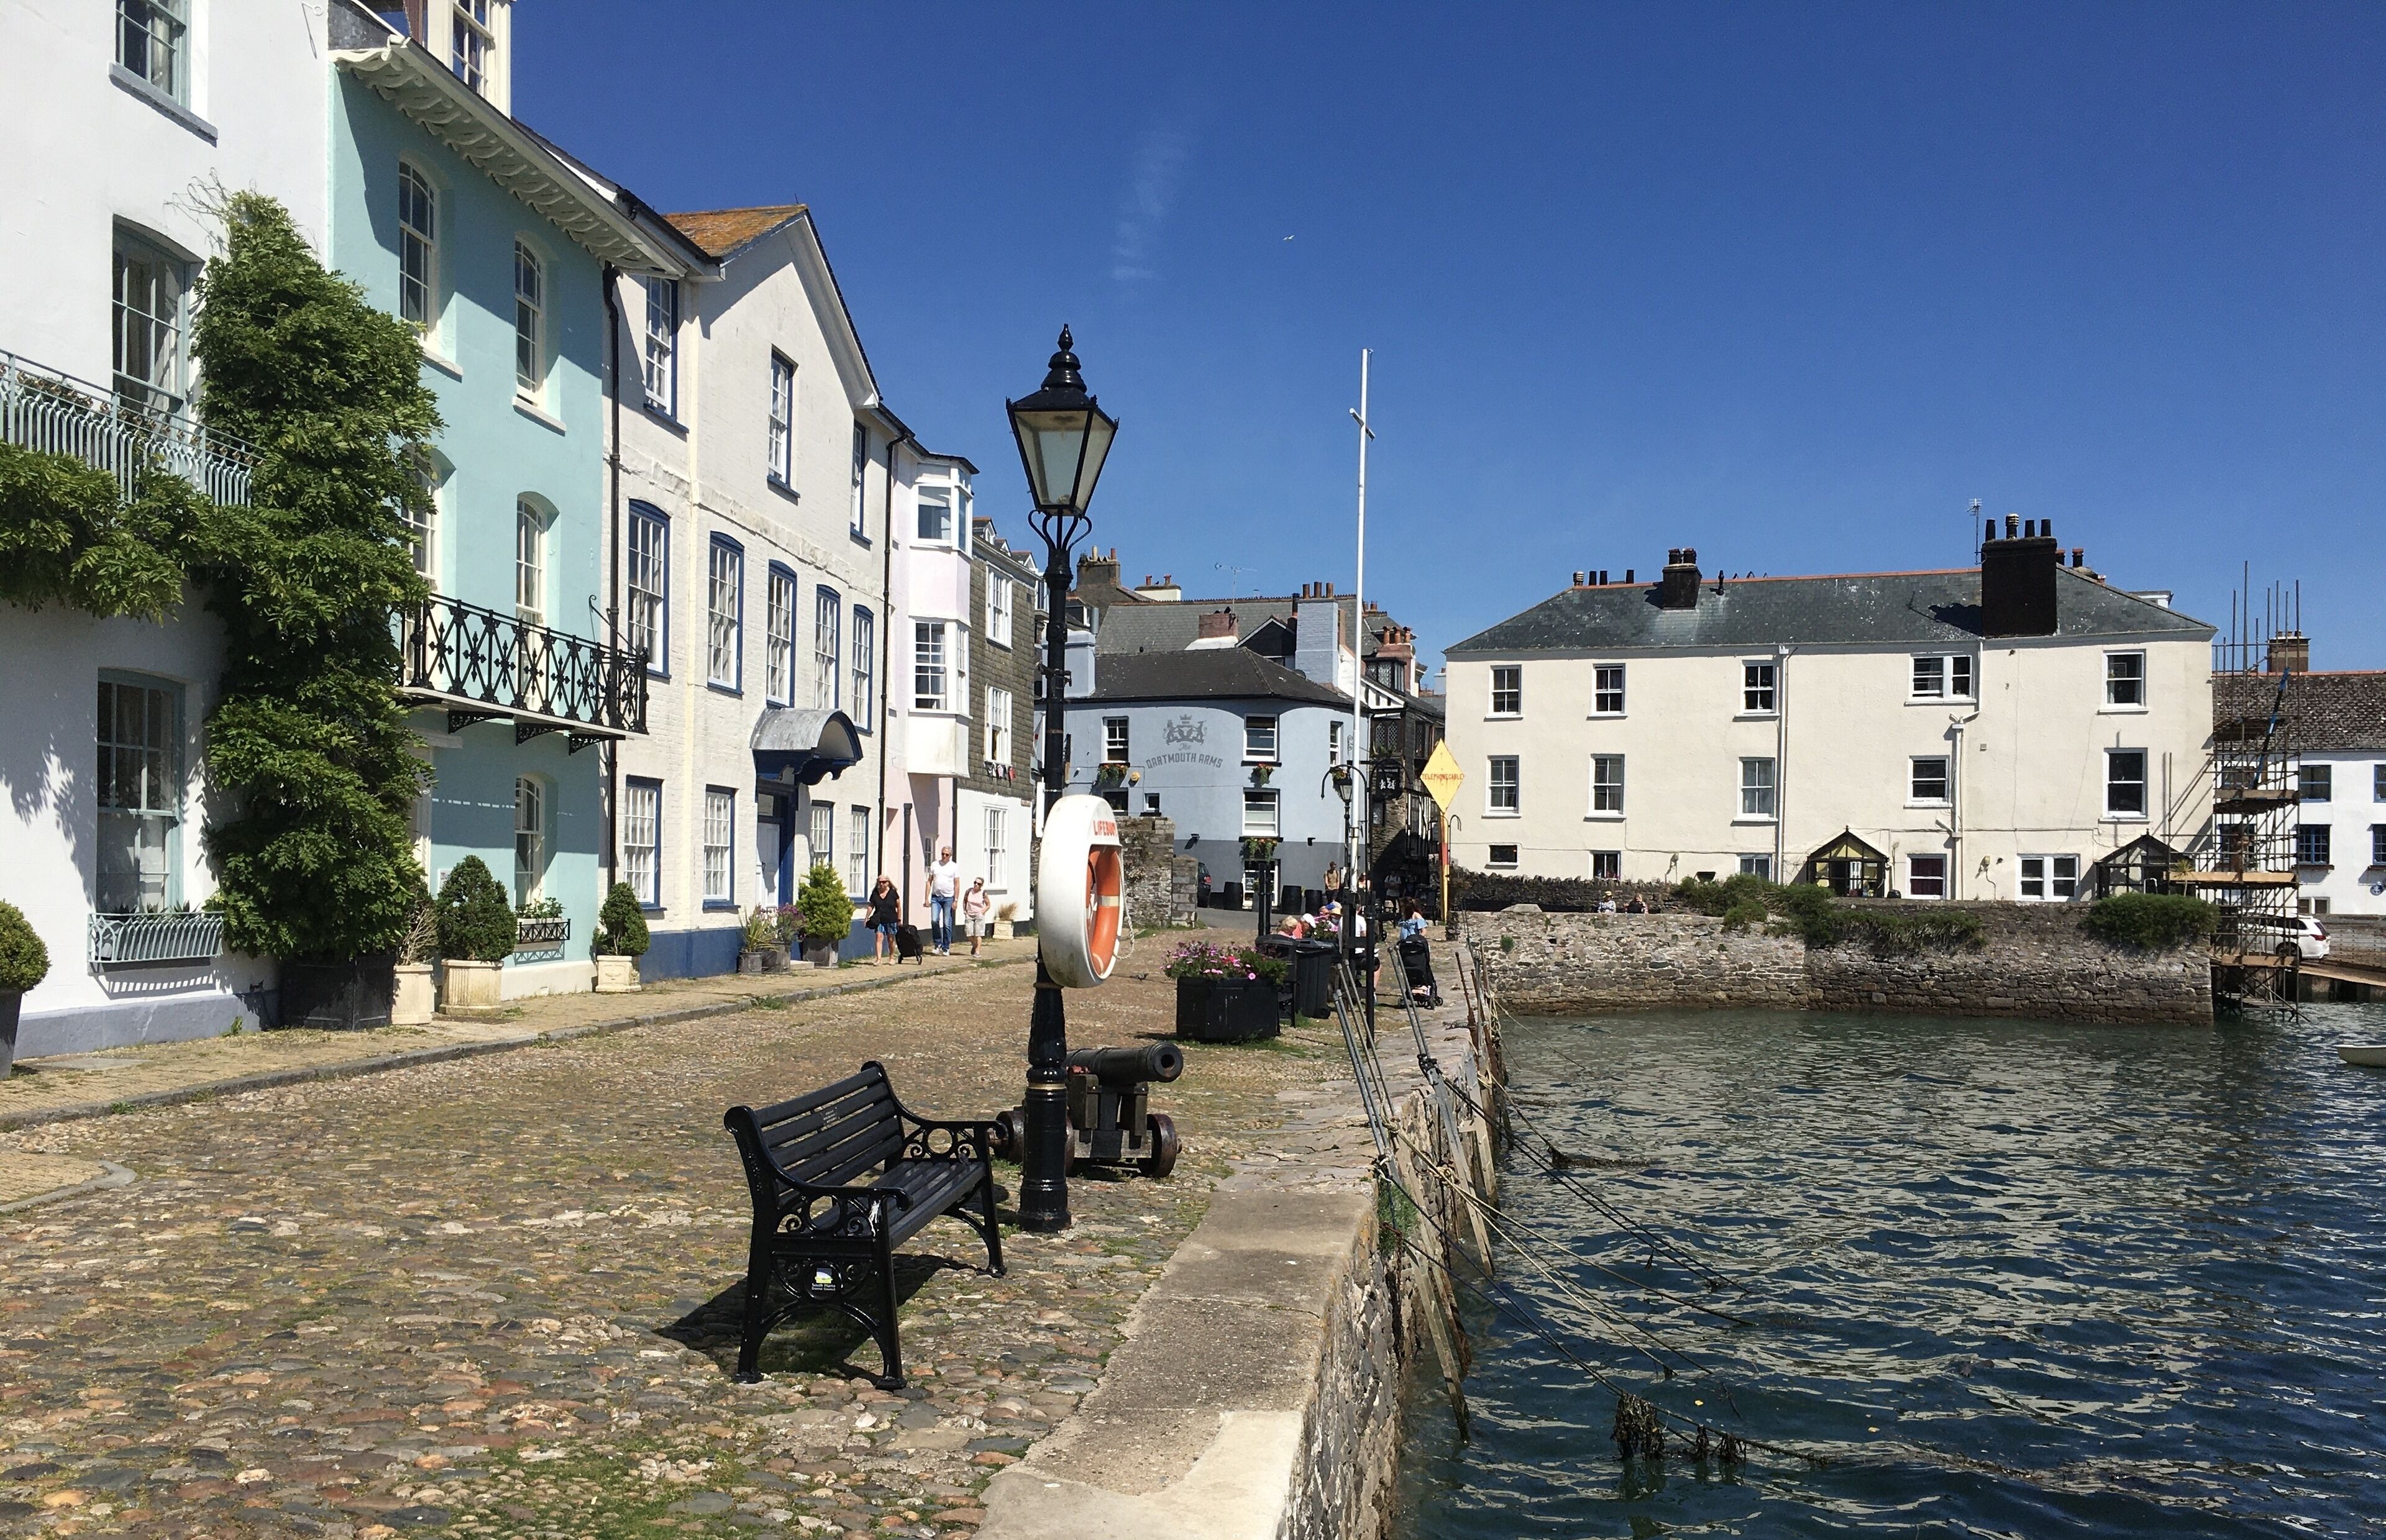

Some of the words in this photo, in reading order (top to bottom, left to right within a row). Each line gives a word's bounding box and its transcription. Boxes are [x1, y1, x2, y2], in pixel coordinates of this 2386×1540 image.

[1178, 742, 1192, 751] The
[1145, 752, 1197, 769] DARTMOUTH
[1199, 753, 1223, 768] ARMS
